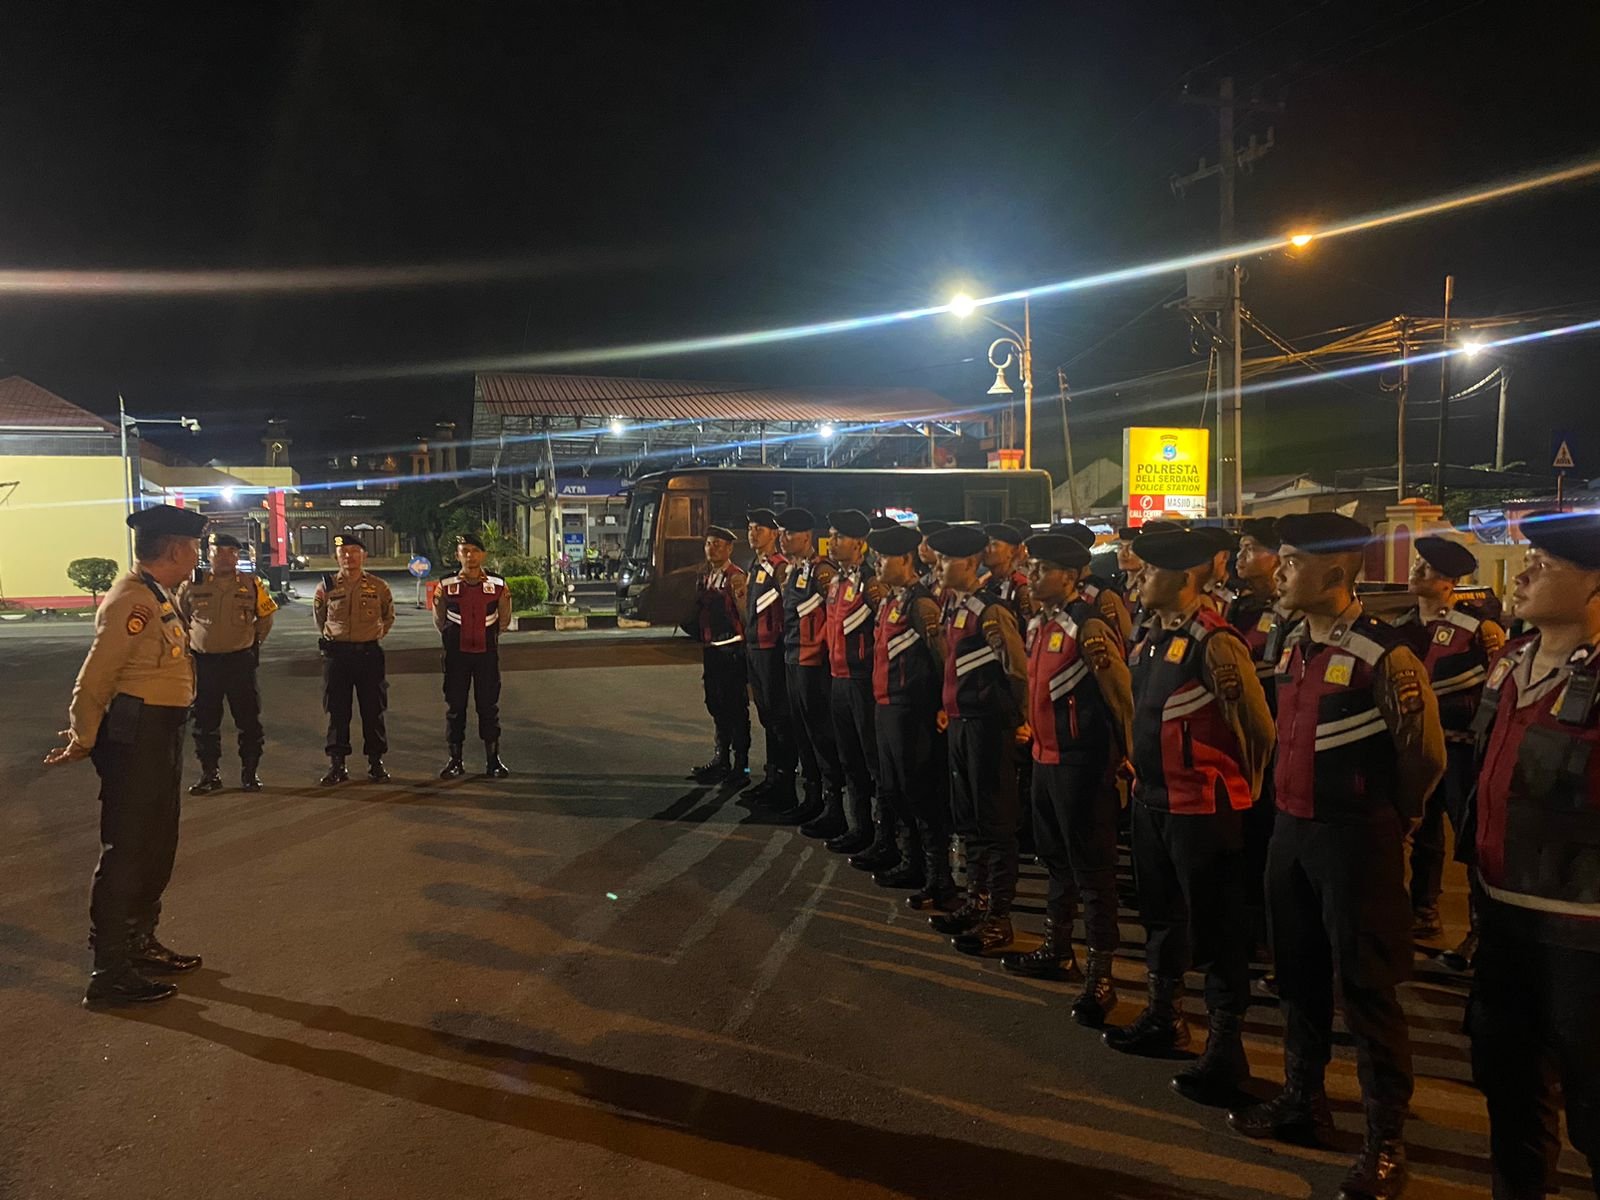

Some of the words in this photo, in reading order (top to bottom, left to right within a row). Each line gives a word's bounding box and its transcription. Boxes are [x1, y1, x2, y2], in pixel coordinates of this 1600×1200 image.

[1137, 464, 1198, 474] POLRESTA
[1158, 475, 1200, 483] SERDANG
[563, 485, 586, 493] ATM
[1166, 484, 1200, 492] STATION
